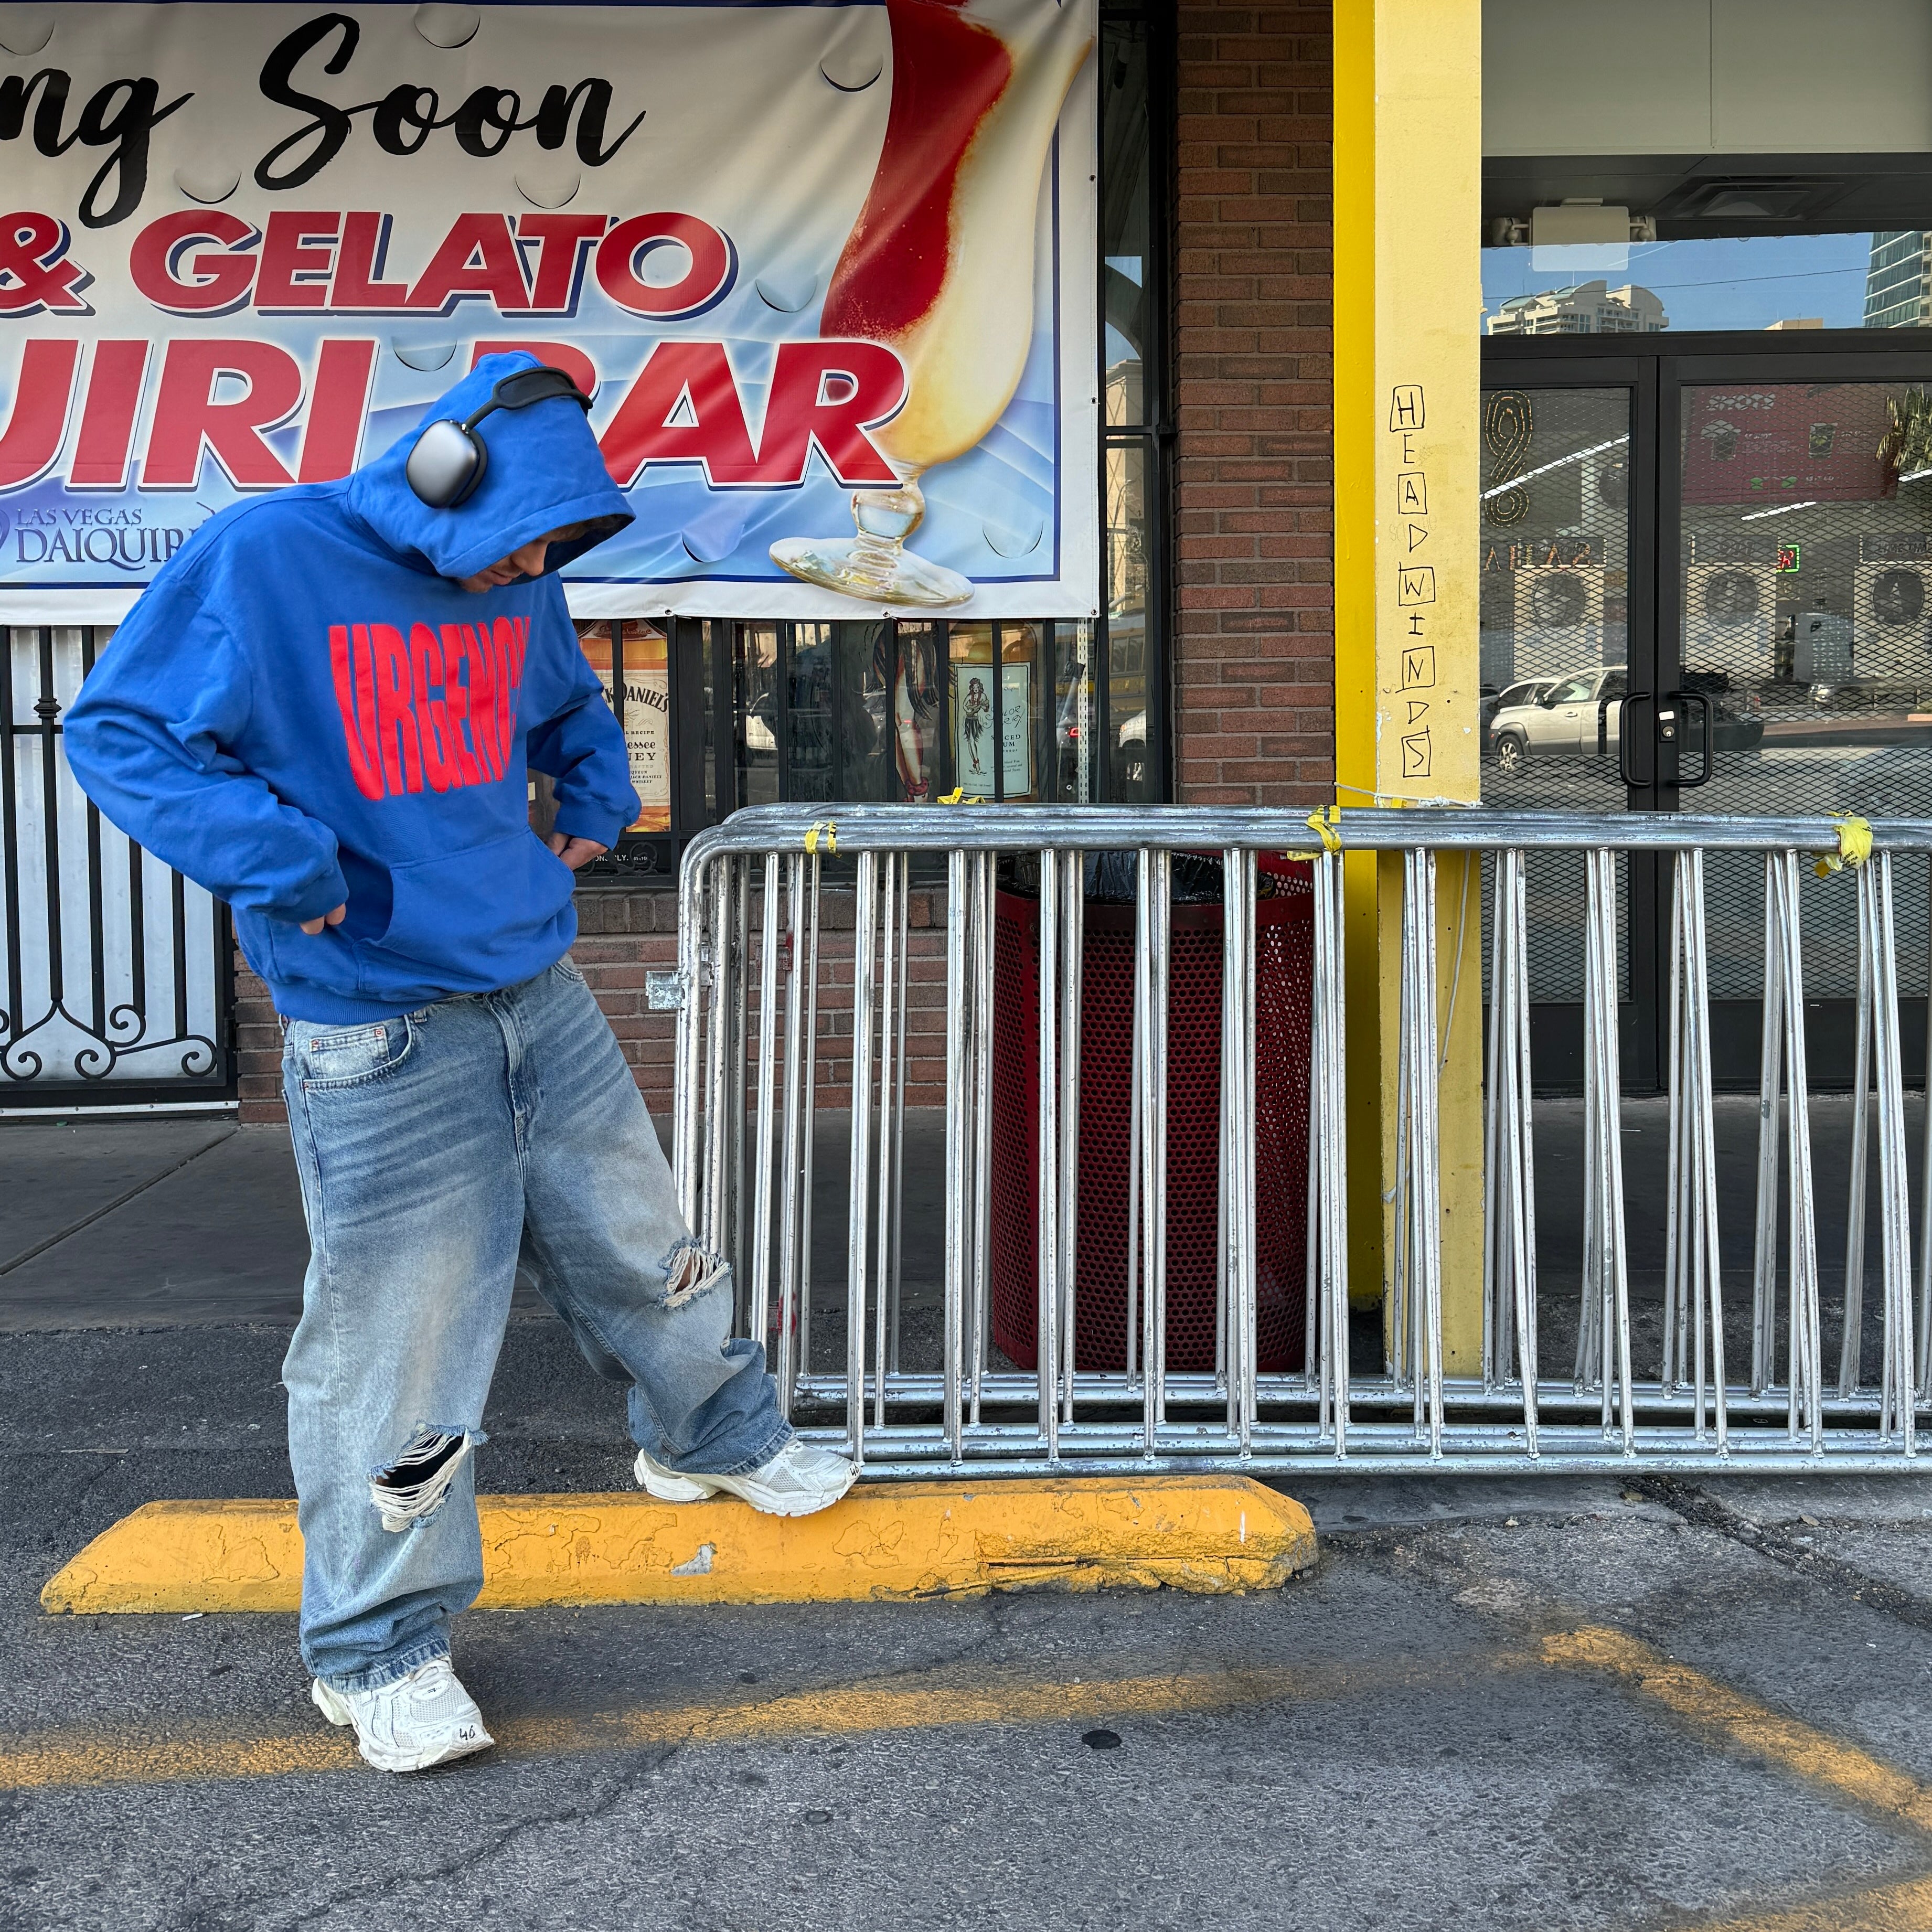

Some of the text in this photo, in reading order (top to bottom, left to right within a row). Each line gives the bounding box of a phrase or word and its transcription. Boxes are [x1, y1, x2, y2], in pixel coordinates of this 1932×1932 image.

[254, 13, 647, 191] Soon
[130, 209, 739, 322] GELATO
[14, 527, 198, 571] DAIQUIR
[17, 507, 142, 526] LAS VEGAS
[1391, 386, 1433, 775] HEADWINDS
[328, 616, 531, 801] URGENCY
[460, 1725, 476, 1741] 46
